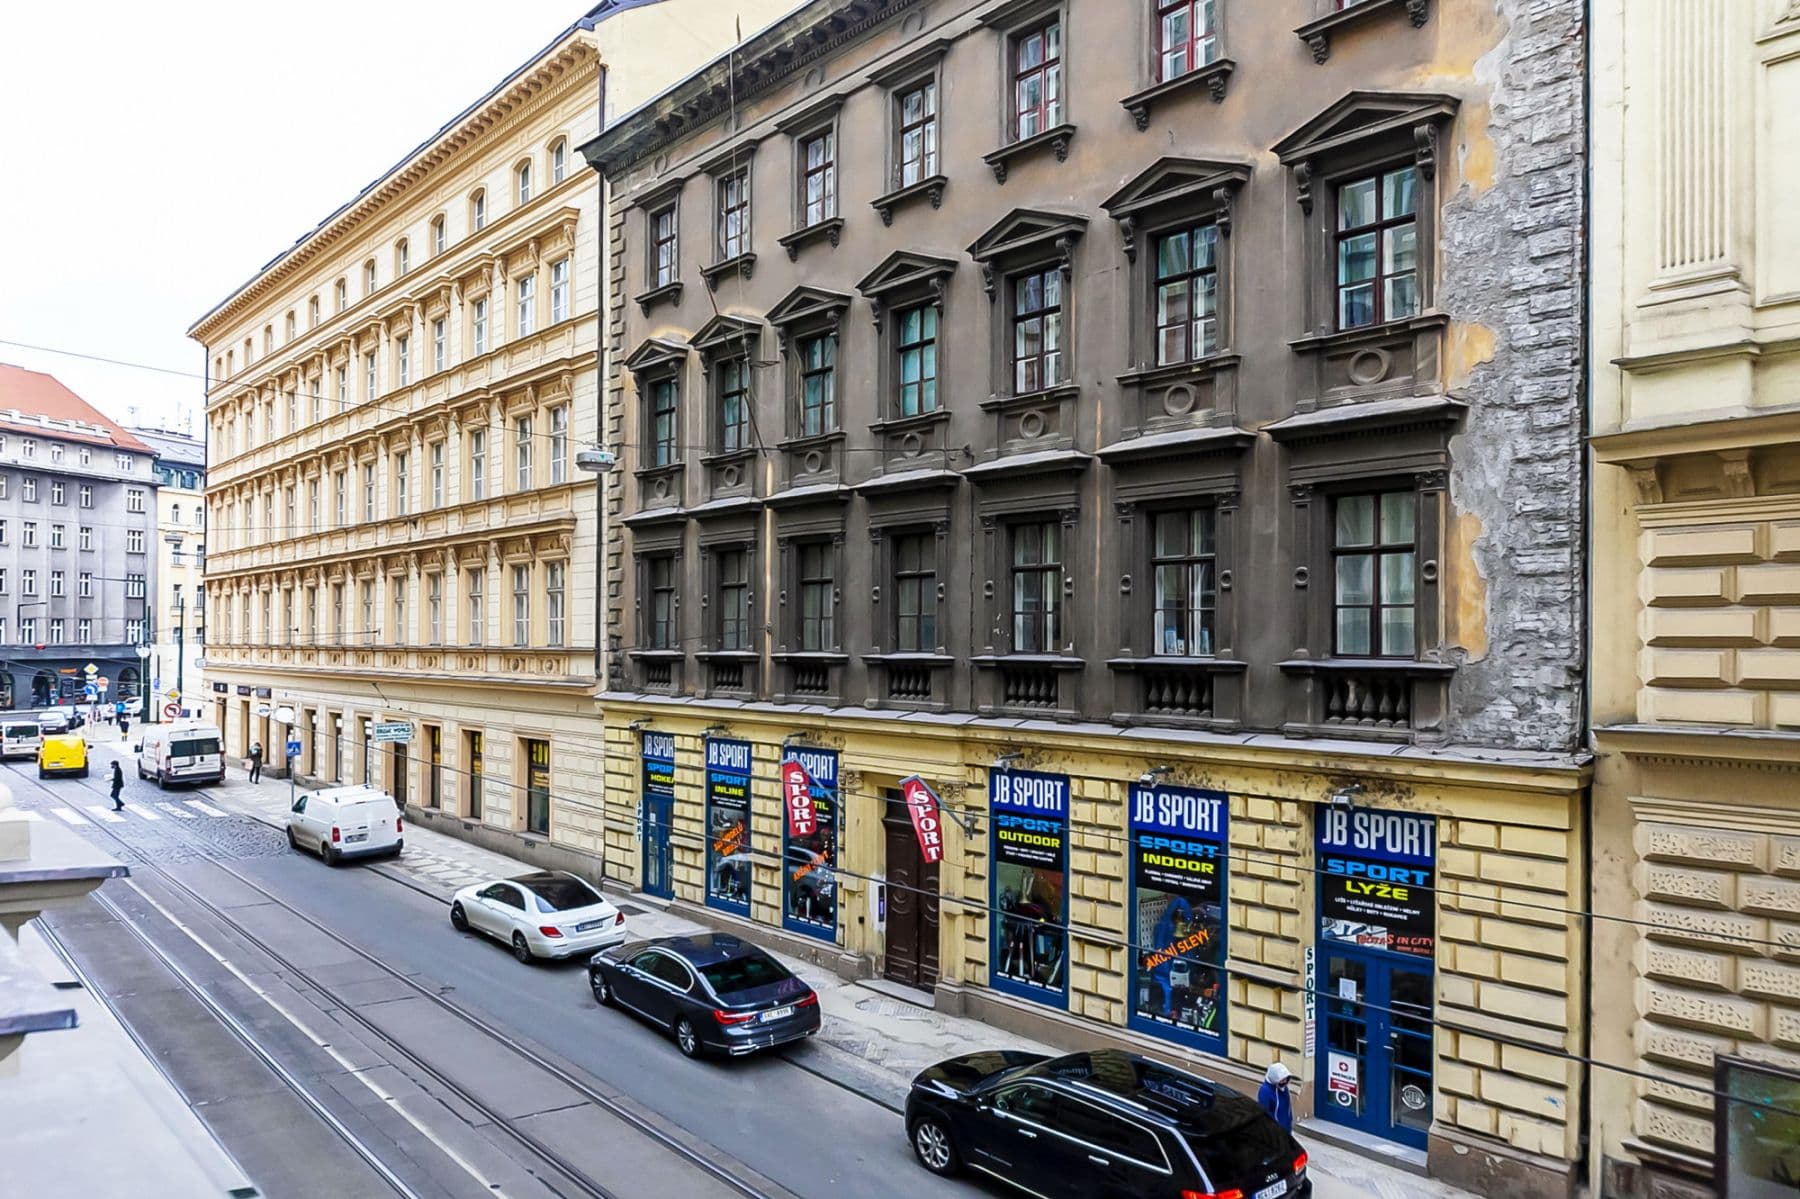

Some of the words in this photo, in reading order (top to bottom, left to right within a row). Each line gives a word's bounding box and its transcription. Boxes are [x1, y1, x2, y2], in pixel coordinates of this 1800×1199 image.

[644, 735, 653, 755] JB
[654, 736, 674, 758] SPOR
[708, 742, 718, 765] JB
[720, 743, 749, 769] SPORT
[647, 762, 674, 774] SPOR
[711, 772, 747, 786] SPORT
[714, 784, 744, 797] INLINE
[790, 771, 812, 834] SPORT
[993, 774, 1010, 804] JB
[1013, 777, 1064, 811] SPORT
[1134, 790, 1154, 823] JB
[1158, 793, 1222, 833] SPORT
[913, 790, 940, 860] SPORT
[998, 814, 1062, 834] SPORT
[1322, 809, 1348, 846] JB
[1354, 812, 1435, 858] SPORT
[999, 830, 1060, 848] OUTDOOR
[1139, 835, 1219, 858] SPORT
[1143, 853, 1215, 875] INDOOR
[1327, 858, 1430, 886] SPORT
[1345, 879, 1409, 901] LYŽE
[1177, 928, 1209, 954] SLEVY
[1306, 948, 1314, 1019] SPORT
